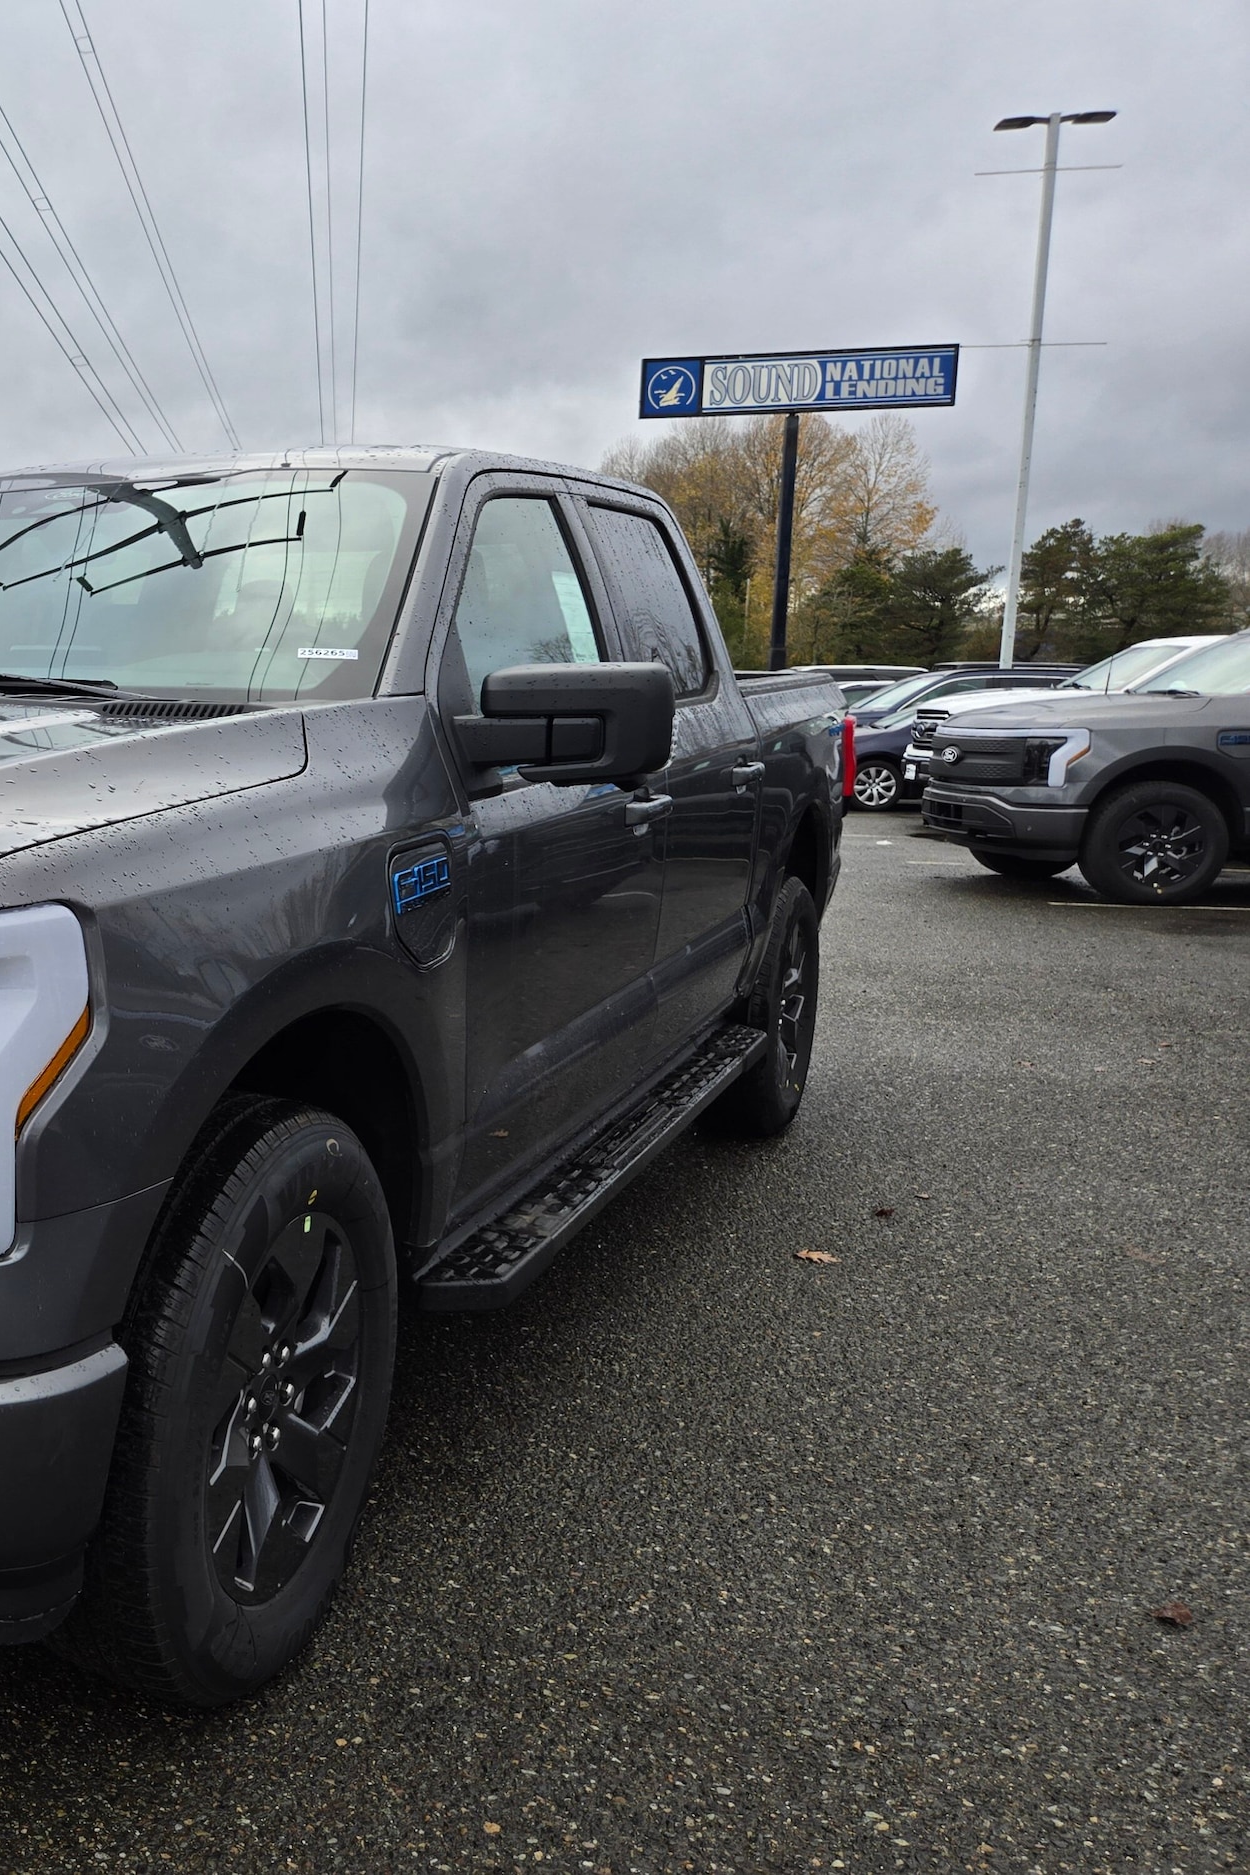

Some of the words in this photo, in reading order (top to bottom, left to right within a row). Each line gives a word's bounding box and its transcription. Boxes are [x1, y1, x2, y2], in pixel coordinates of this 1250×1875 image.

[825, 357, 945, 382] NATIONAL
[710, 362, 818, 406] SOUND
[825, 377, 945, 400] LENDING
